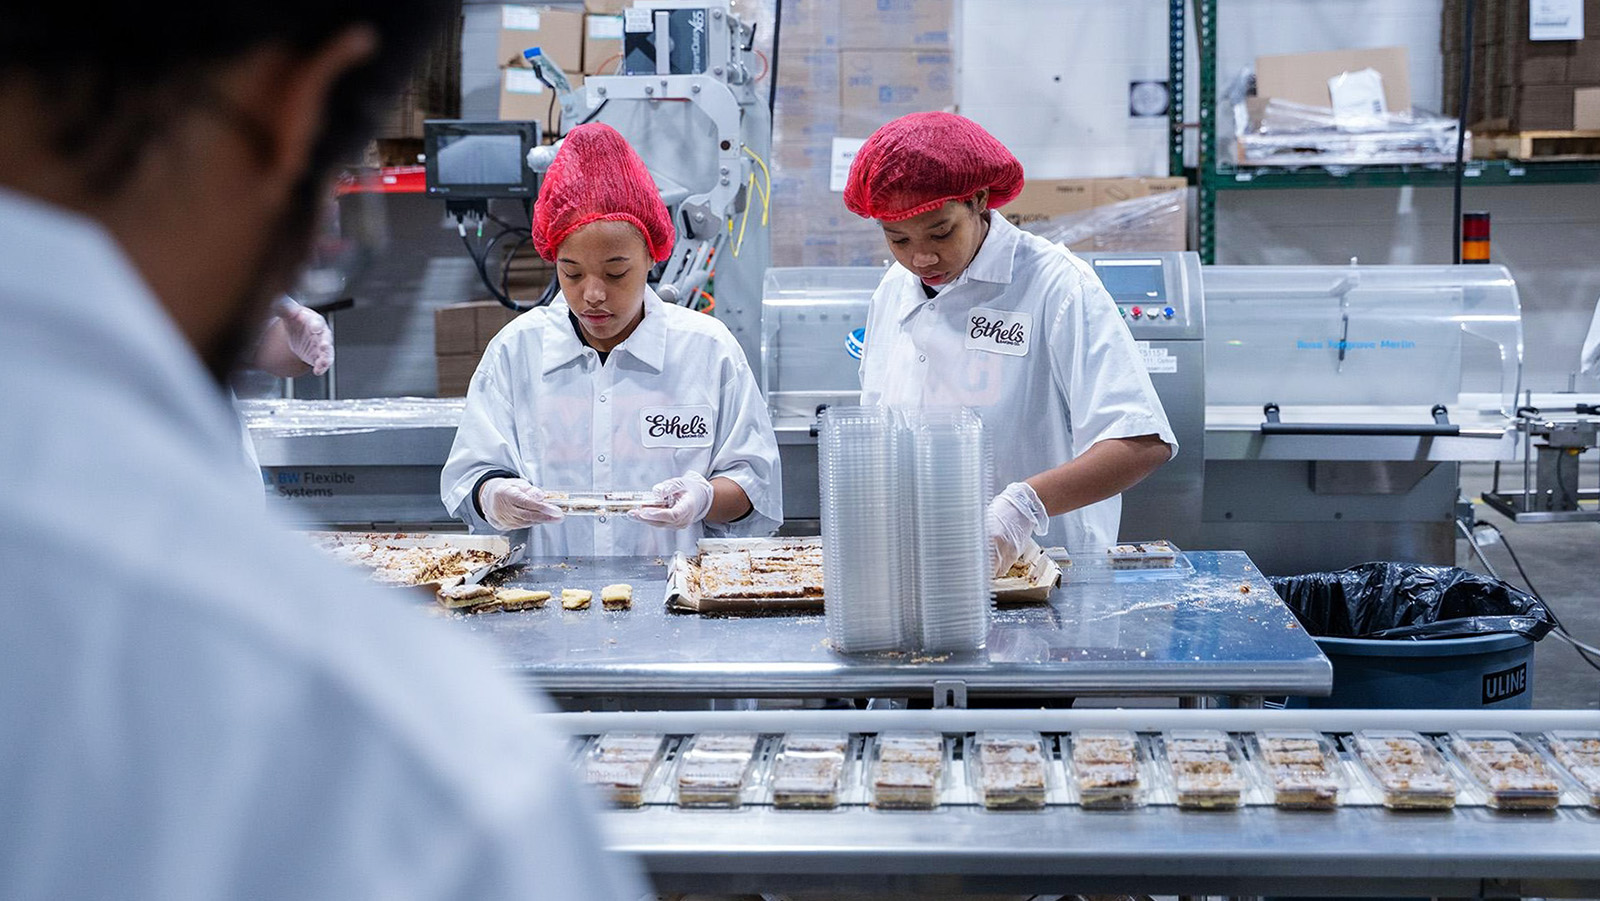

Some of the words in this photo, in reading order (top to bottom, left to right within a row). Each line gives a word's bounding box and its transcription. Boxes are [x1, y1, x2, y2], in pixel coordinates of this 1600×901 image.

[279, 472, 299, 483] BW
[303, 472, 355, 484] Flexible
[278, 486, 333, 500] Systems
[1486, 668, 1525, 698] ULINE
